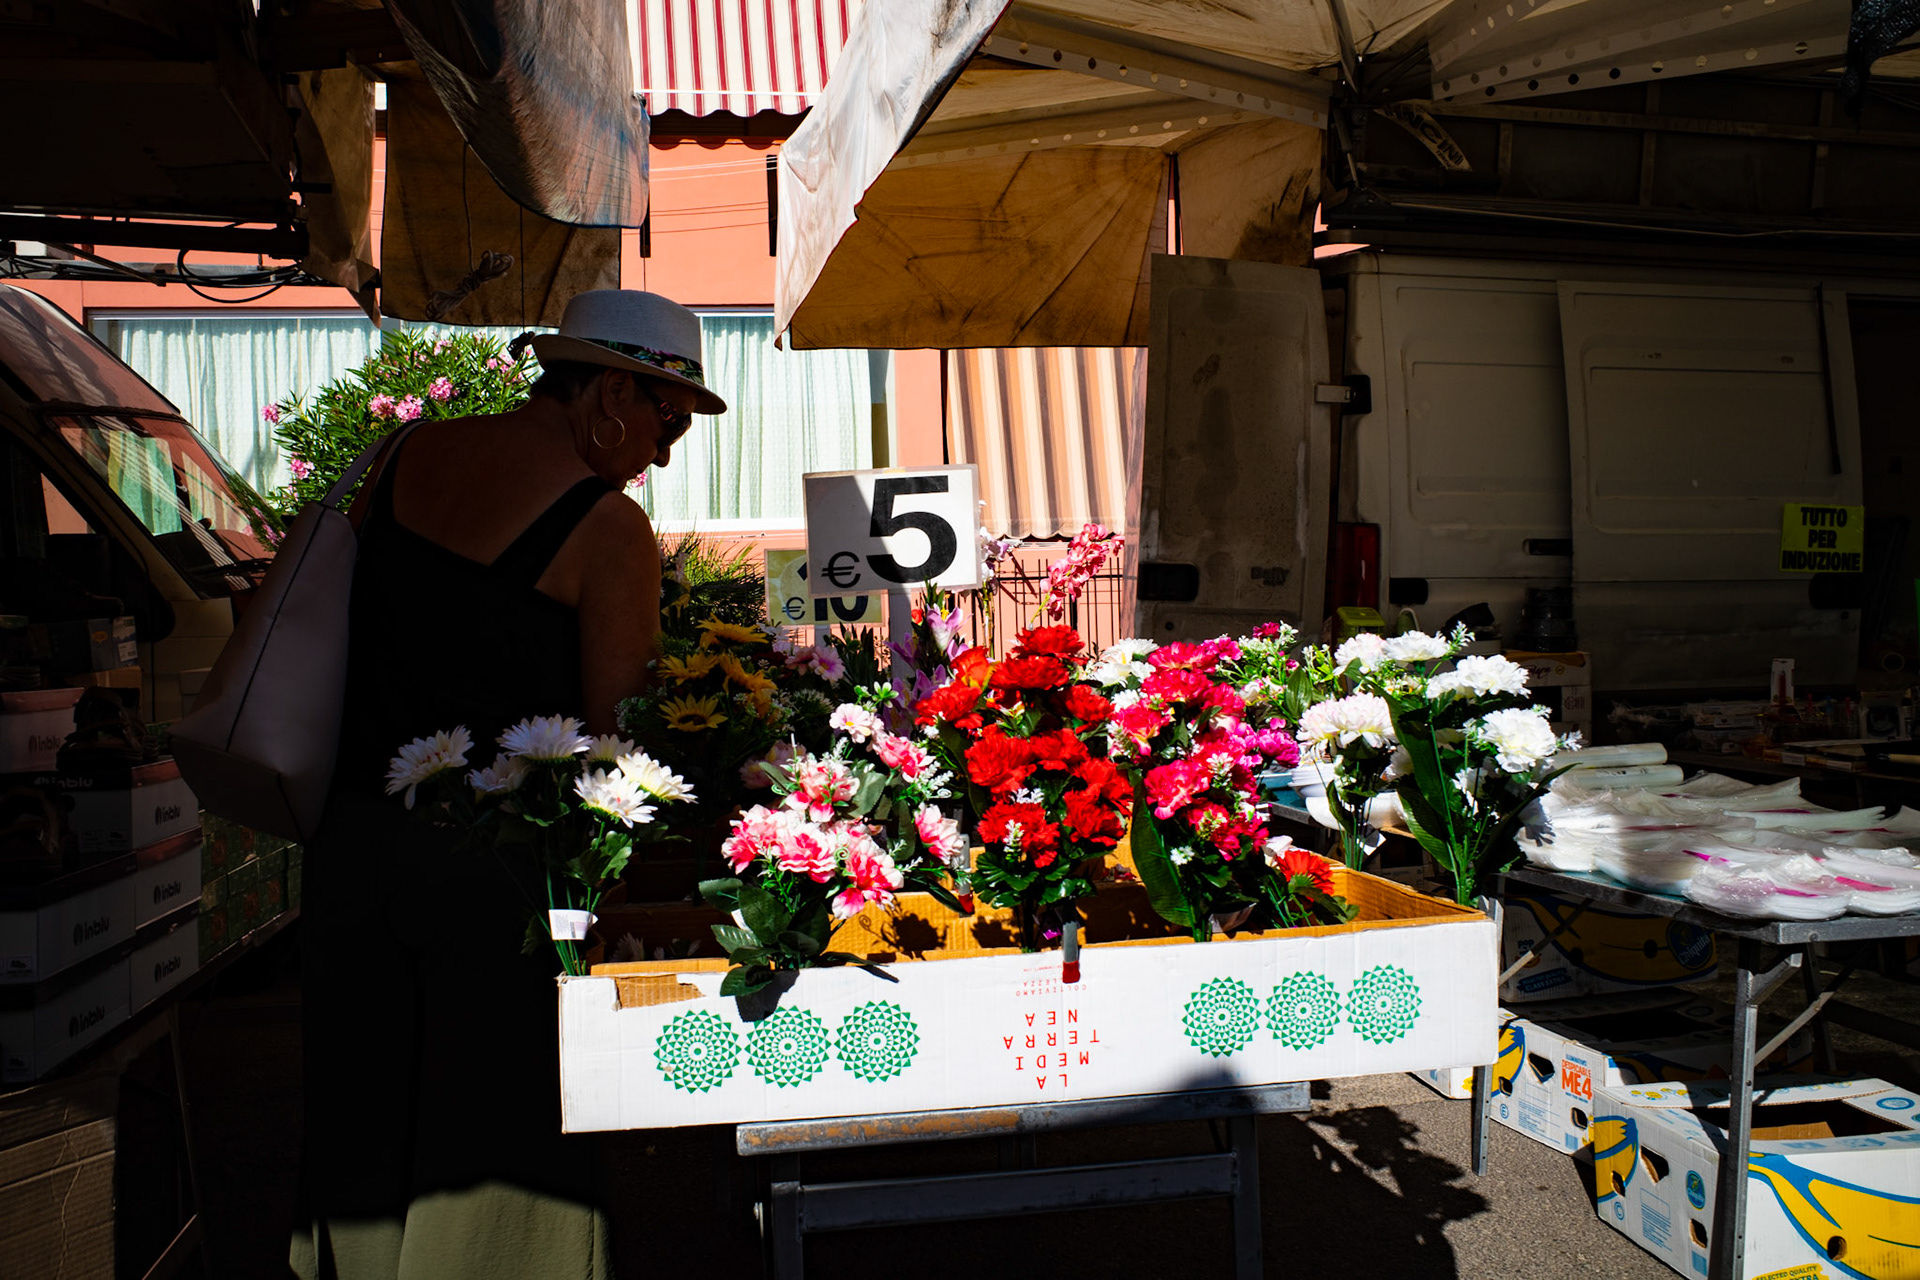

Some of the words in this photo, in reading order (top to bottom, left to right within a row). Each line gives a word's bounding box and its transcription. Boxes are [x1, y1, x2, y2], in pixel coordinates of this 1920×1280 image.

[1801, 507, 1847, 527] TUTTO
[1808, 530, 1837, 549] PER
[1782, 551, 1861, 571] INDUZIONE
[162, 880, 181, 901] inblu
[84, 916, 110, 940] inblu
[162, 956, 181, 978] inblu
[79, 1005, 105, 1032] inblu
[1025, 1009, 1078, 1027] NEA
[1003, 1029, 1100, 1050] TERRA
[1015, 1051, 1089, 1071] MEDI
[1036, 1073, 1067, 1090] LA
[1789, 1265, 1817, 1277] QUALITY
